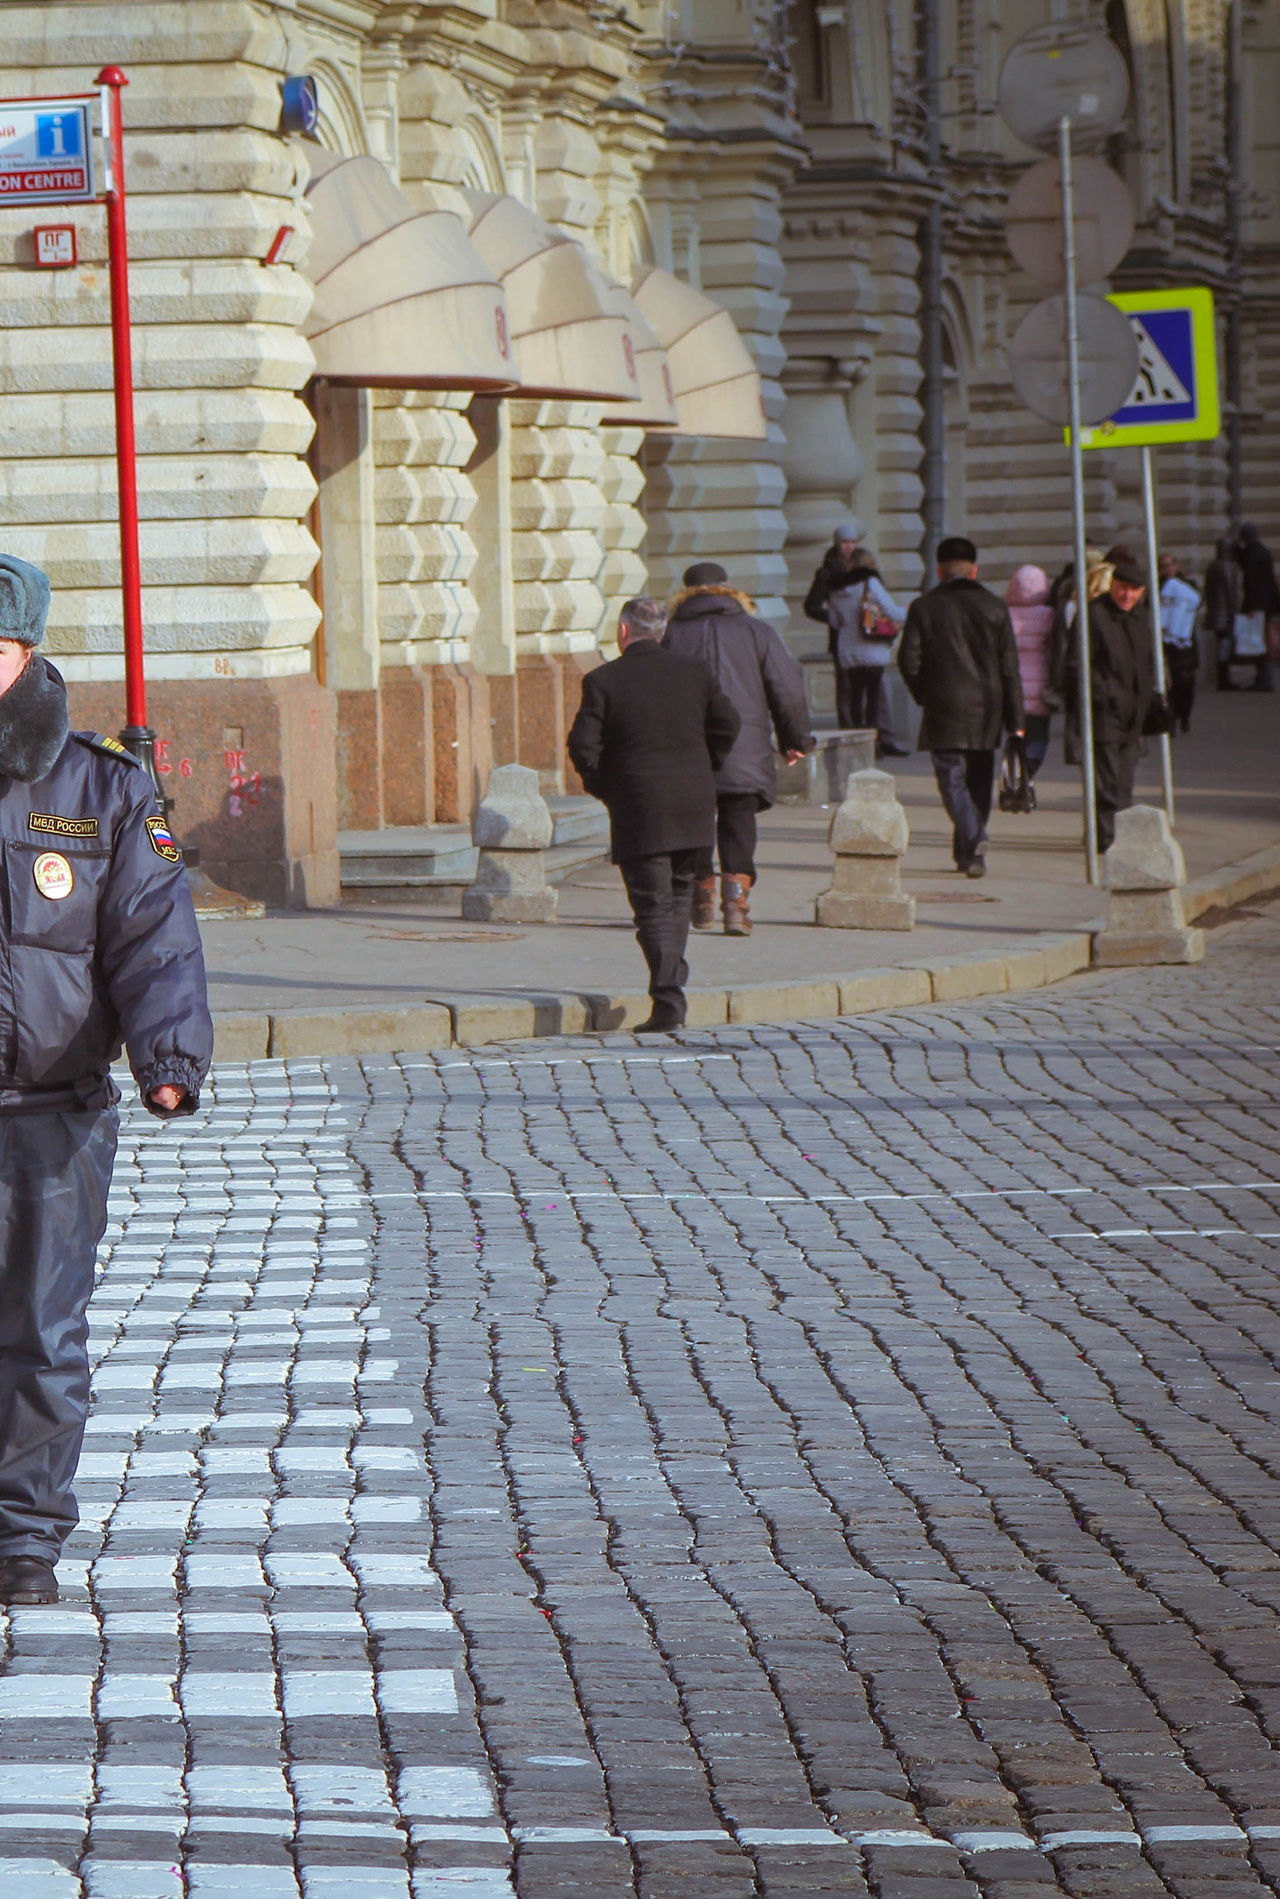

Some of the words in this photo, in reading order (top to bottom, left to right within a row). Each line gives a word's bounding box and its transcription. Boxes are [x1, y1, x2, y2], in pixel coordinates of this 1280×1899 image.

[25, 171, 83, 189] CENTRE
[33, 817, 55, 831] МВД
[56, 821, 94, 833] РОССИИ
